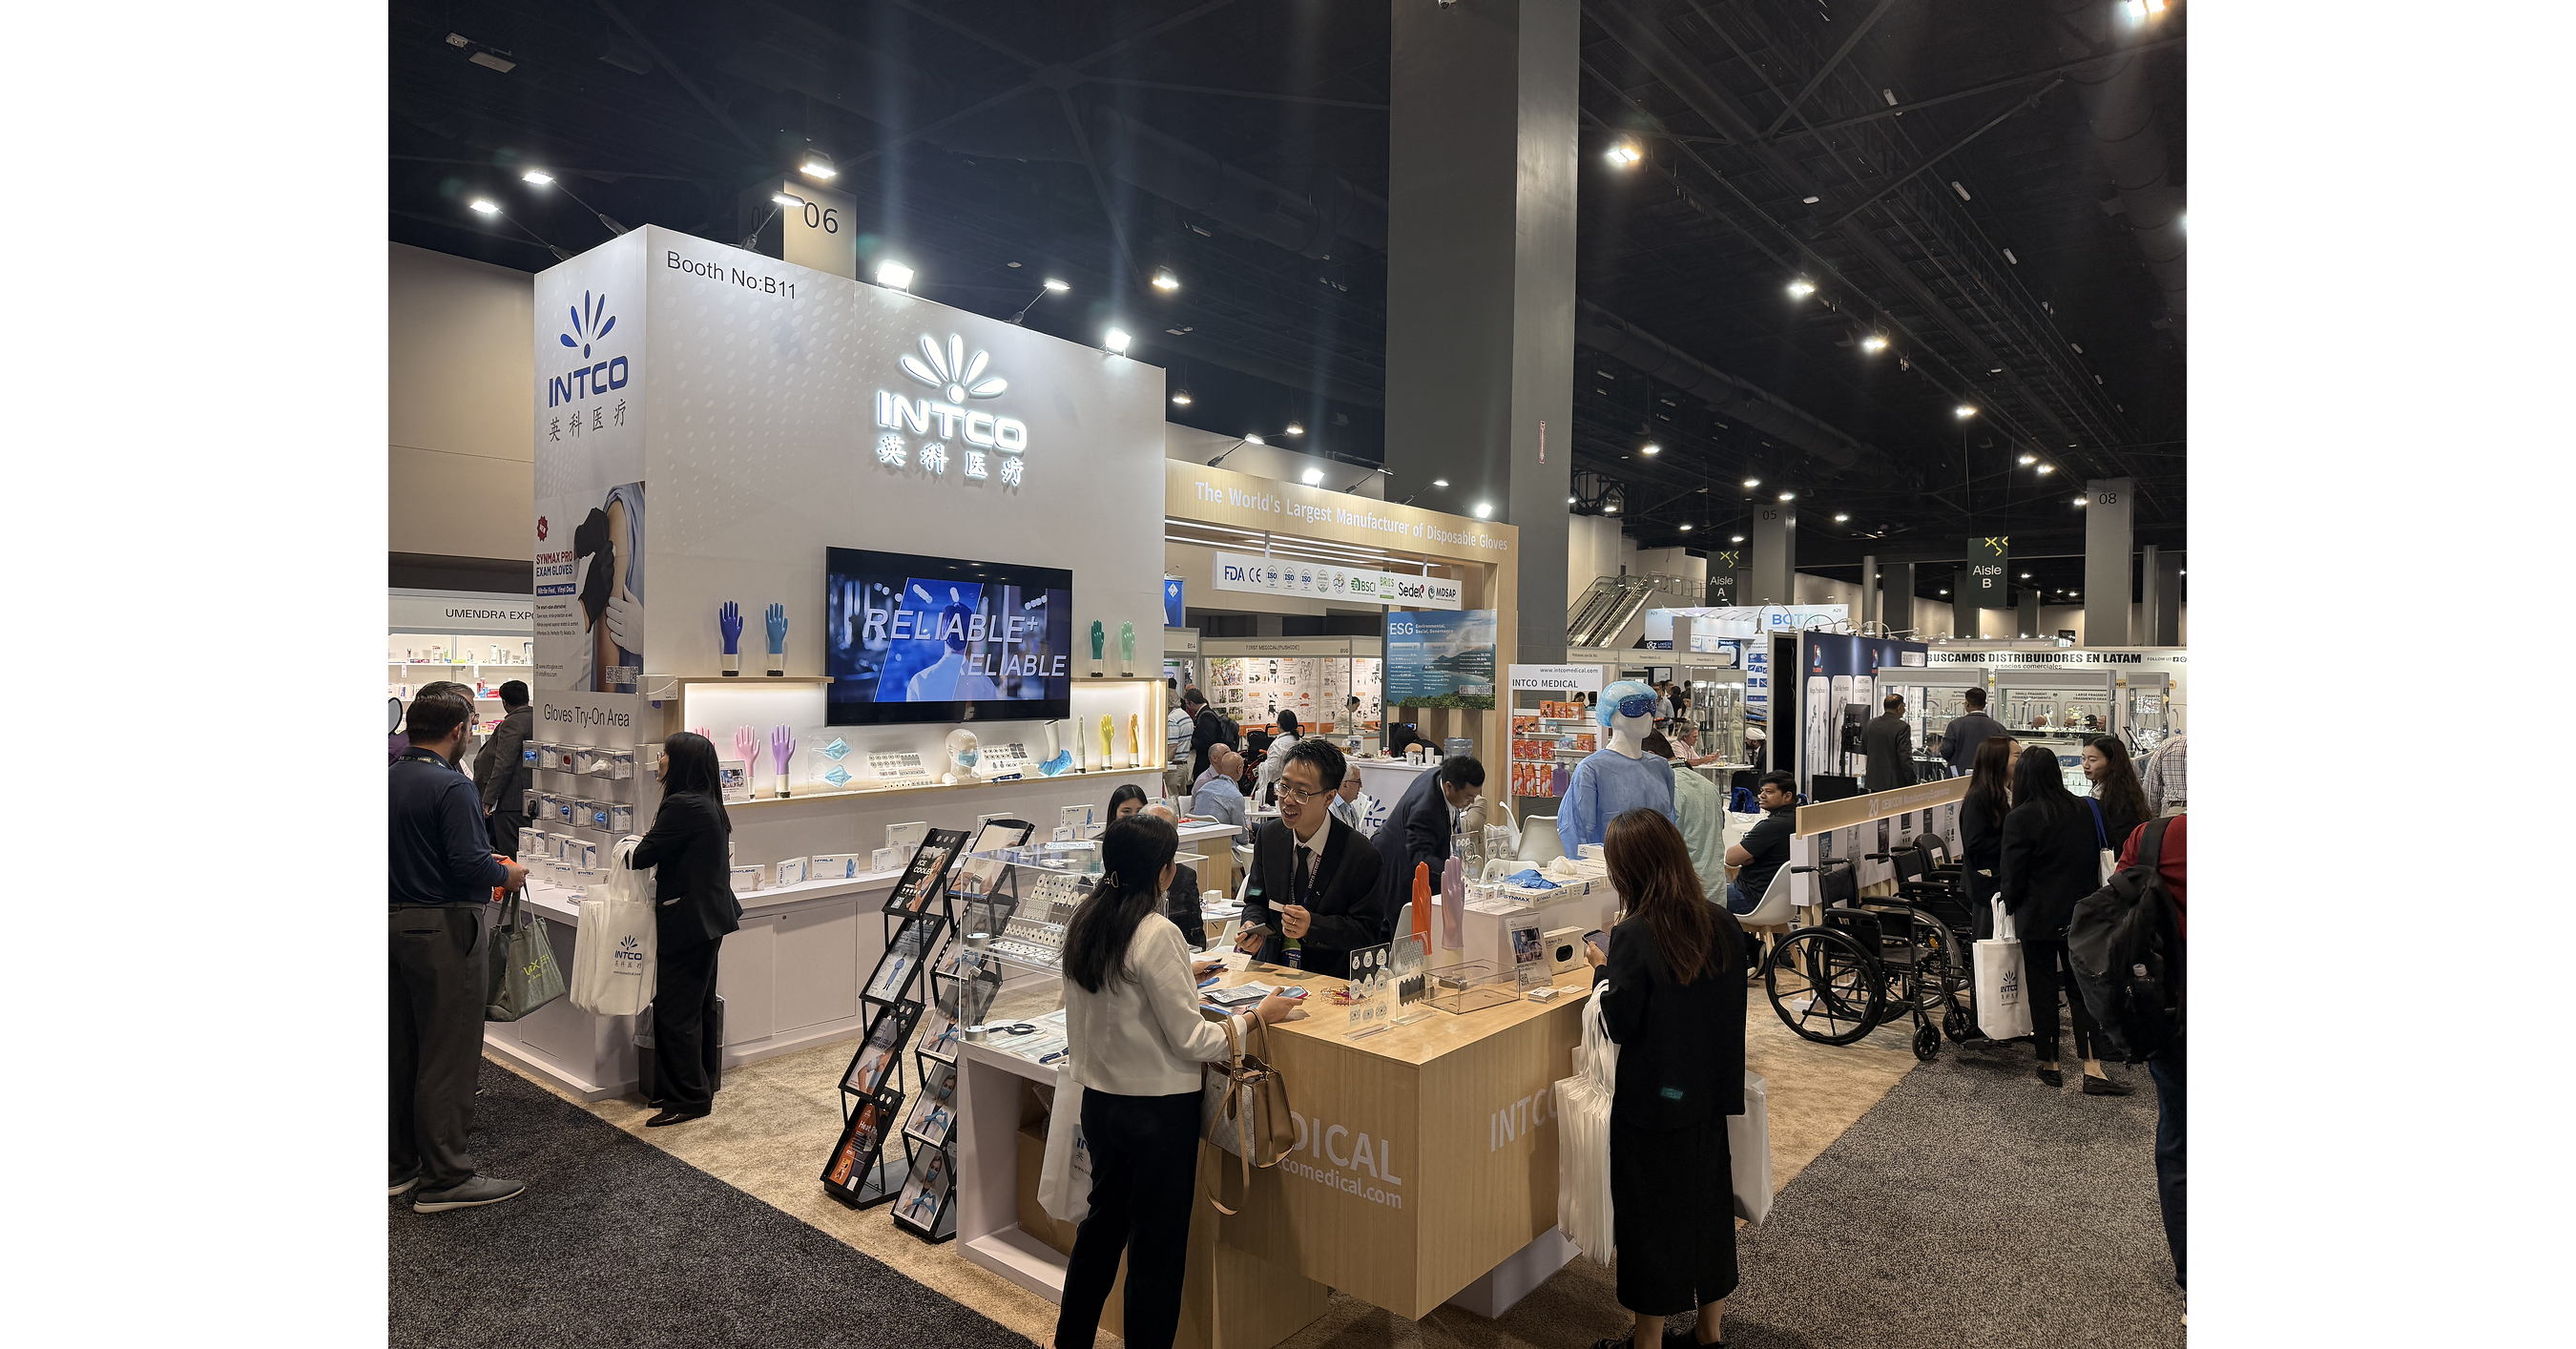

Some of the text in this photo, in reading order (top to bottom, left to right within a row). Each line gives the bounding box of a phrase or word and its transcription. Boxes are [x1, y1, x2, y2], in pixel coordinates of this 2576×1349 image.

[803, 201, 839, 234] 06
[667, 250, 796, 299] Booth No:B11
[549, 355, 629, 408] INTCO
[549, 399, 627, 443] 英科医疗
[878, 391, 1028, 452] INTCO
[878, 435, 1025, 486] 英科医疗
[2098, 492, 2118, 506] 08
[1195, 481, 1507, 550] The World's Largest Manufacturer of Disposable Gloves
[1762, 509, 1777, 521] 05
[536, 550, 572, 565] SYNMAX PRO
[536, 565, 572, 577] EXAM GLOVES
[1224, 565, 1245, 582] FDA
[1267, 571, 1278, 580] ISO
[1972, 565, 2002, 576] Aisle
[1361, 580, 1376, 592] BSCI
[1710, 575, 1734, 586] Aisle
[1982, 578, 1992, 589] B
[1398, 581, 1424, 598] Sedex
[1436, 587, 1457, 598] MDSAP
[1717, 588, 1726, 596] A
[446, 609, 506, 619] UMENDRA
[1389, 622, 1414, 635] ESG
[1927, 653, 1985, 663] BUSCAMOS
[1988, 653, 2084, 663] DISTRIBUIDORES
[2086, 654, 2100, 663] EN
[2103, 654, 2142, 663] LATAM
[1512, 678, 1578, 689] INTCO MEDICAL
[544, 703, 630, 728] Gloves Try-On Area
[1364, 818, 1386, 827] TC
[913, 866, 934, 875] COOLER
[614, 950, 643, 961] INTCO
[859, 1120, 871, 1131] Heat
